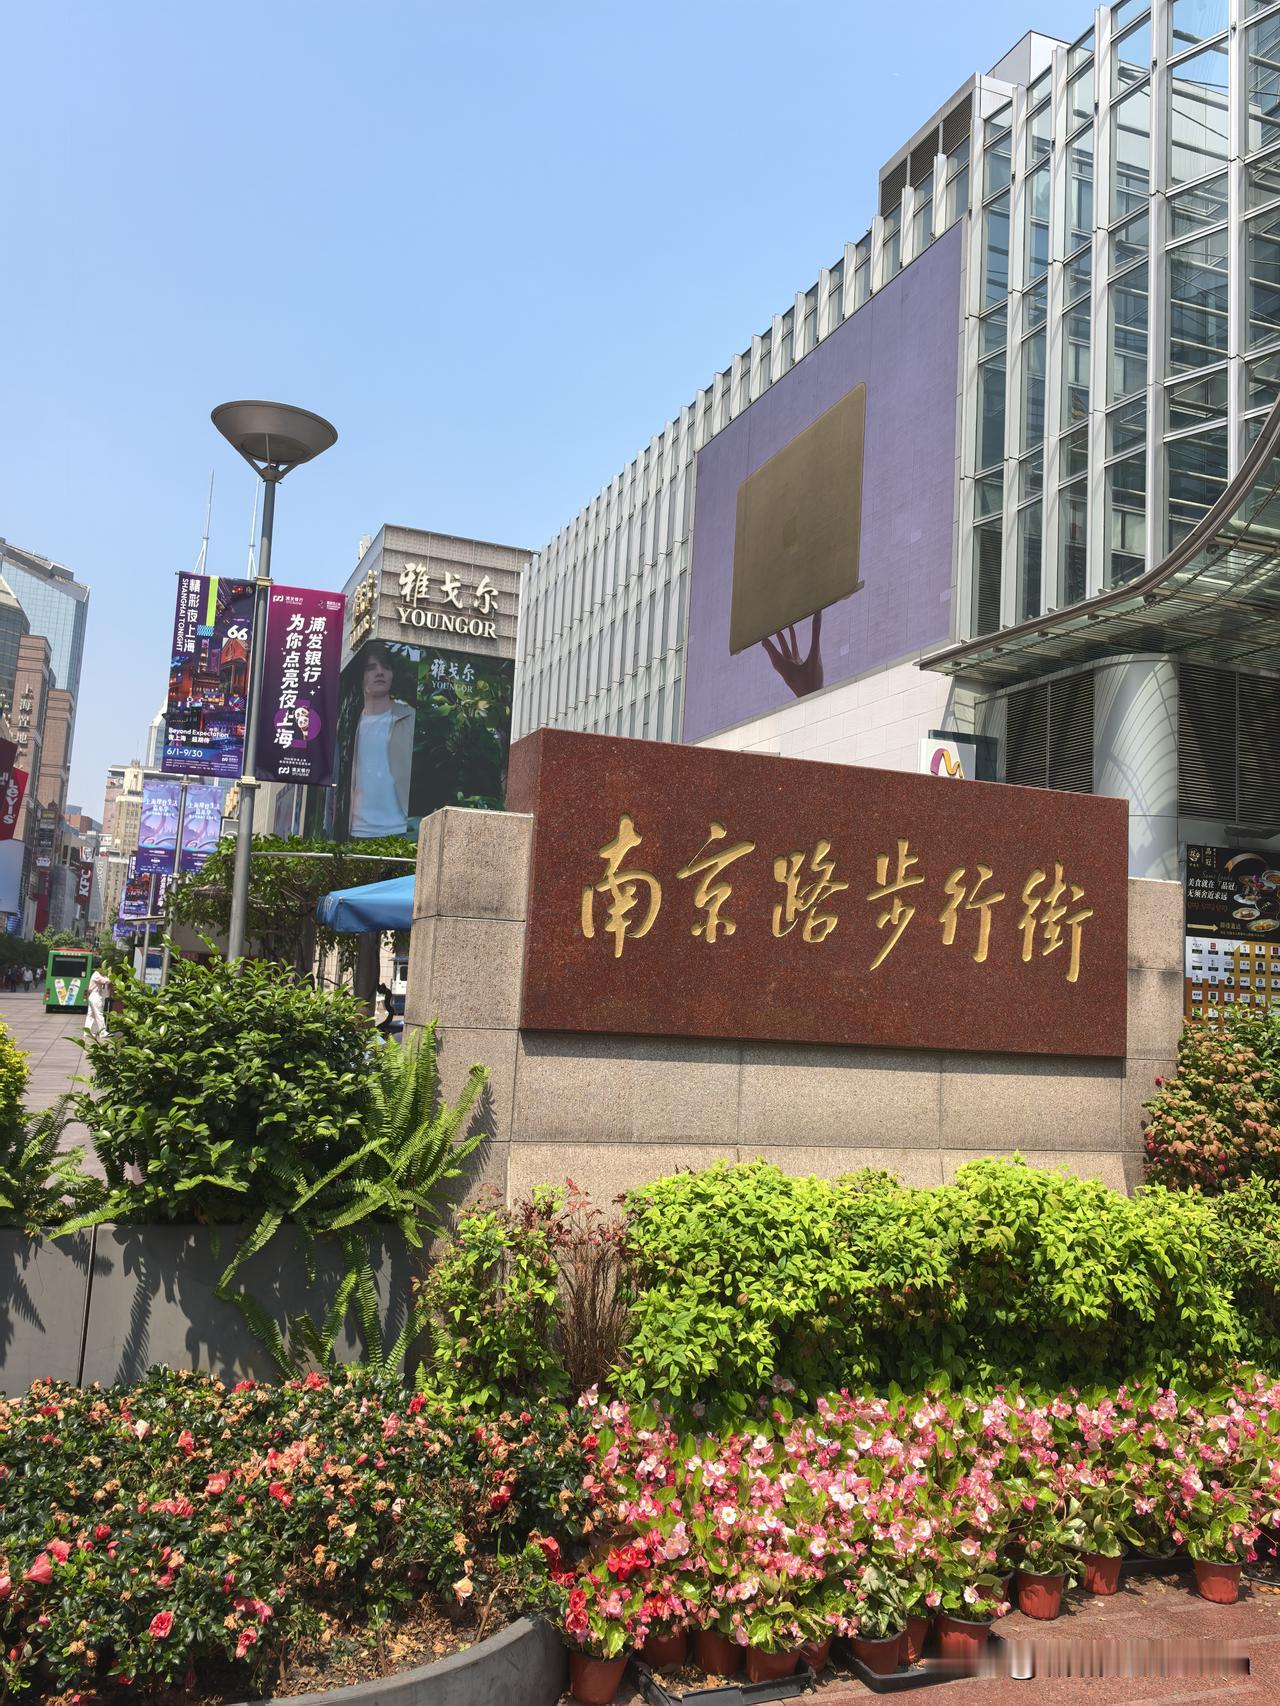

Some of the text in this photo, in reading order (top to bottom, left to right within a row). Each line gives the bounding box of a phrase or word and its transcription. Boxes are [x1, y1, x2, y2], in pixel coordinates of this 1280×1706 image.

[398, 562, 499, 614] 雅戈尔
[176, 578, 189, 652] SHANGHAI TONIGHT
[397, 606, 498, 639] YOUNGOR
[227, 624, 249, 641] 66
[302, 616, 327, 683] 浦发银行
[273, 613, 305, 749] 为你点亮夜上海
[430, 658, 475, 682] 雅戈尔
[431, 680, 473, 694] YOUNGOR
[168, 726, 229, 738] Beyond Expectation
[166, 747, 203, 758] 6/1-9/30
[79, 869, 91, 897] KFC
[581, 812, 1094, 983] 南京路步行街
